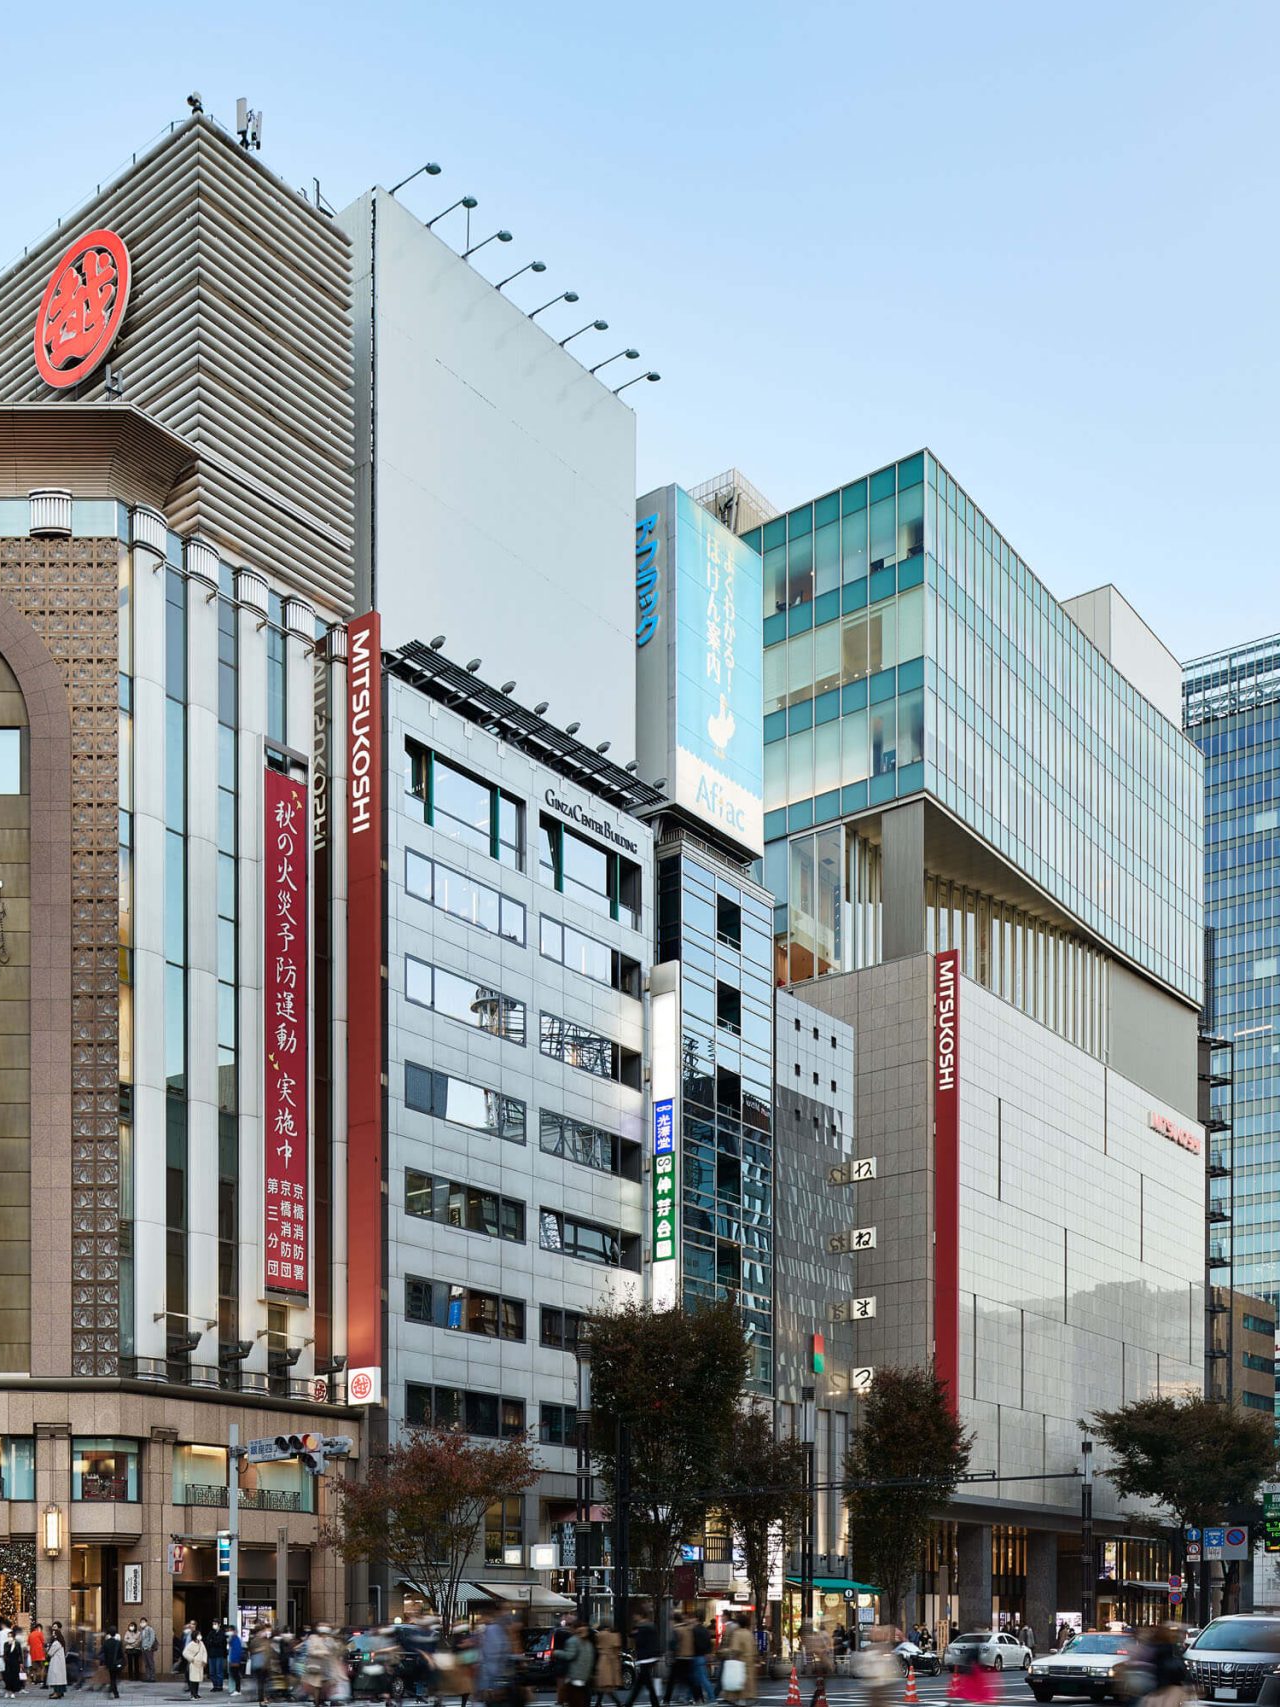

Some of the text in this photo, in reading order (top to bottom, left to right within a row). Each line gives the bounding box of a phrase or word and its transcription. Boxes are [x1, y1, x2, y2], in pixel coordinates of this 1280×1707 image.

[352, 628, 370, 834] MITSUKOSHI
[274, 800, 298, 1169] 秋の火災予防運動 実施中
[938, 960, 956, 1092] MITSUKOSHI
[267, 1178, 279, 1277] 第三分団
[280, 1180, 292, 1279] 京橋消防団
[293, 1183, 304, 1281] 京橋消防署
